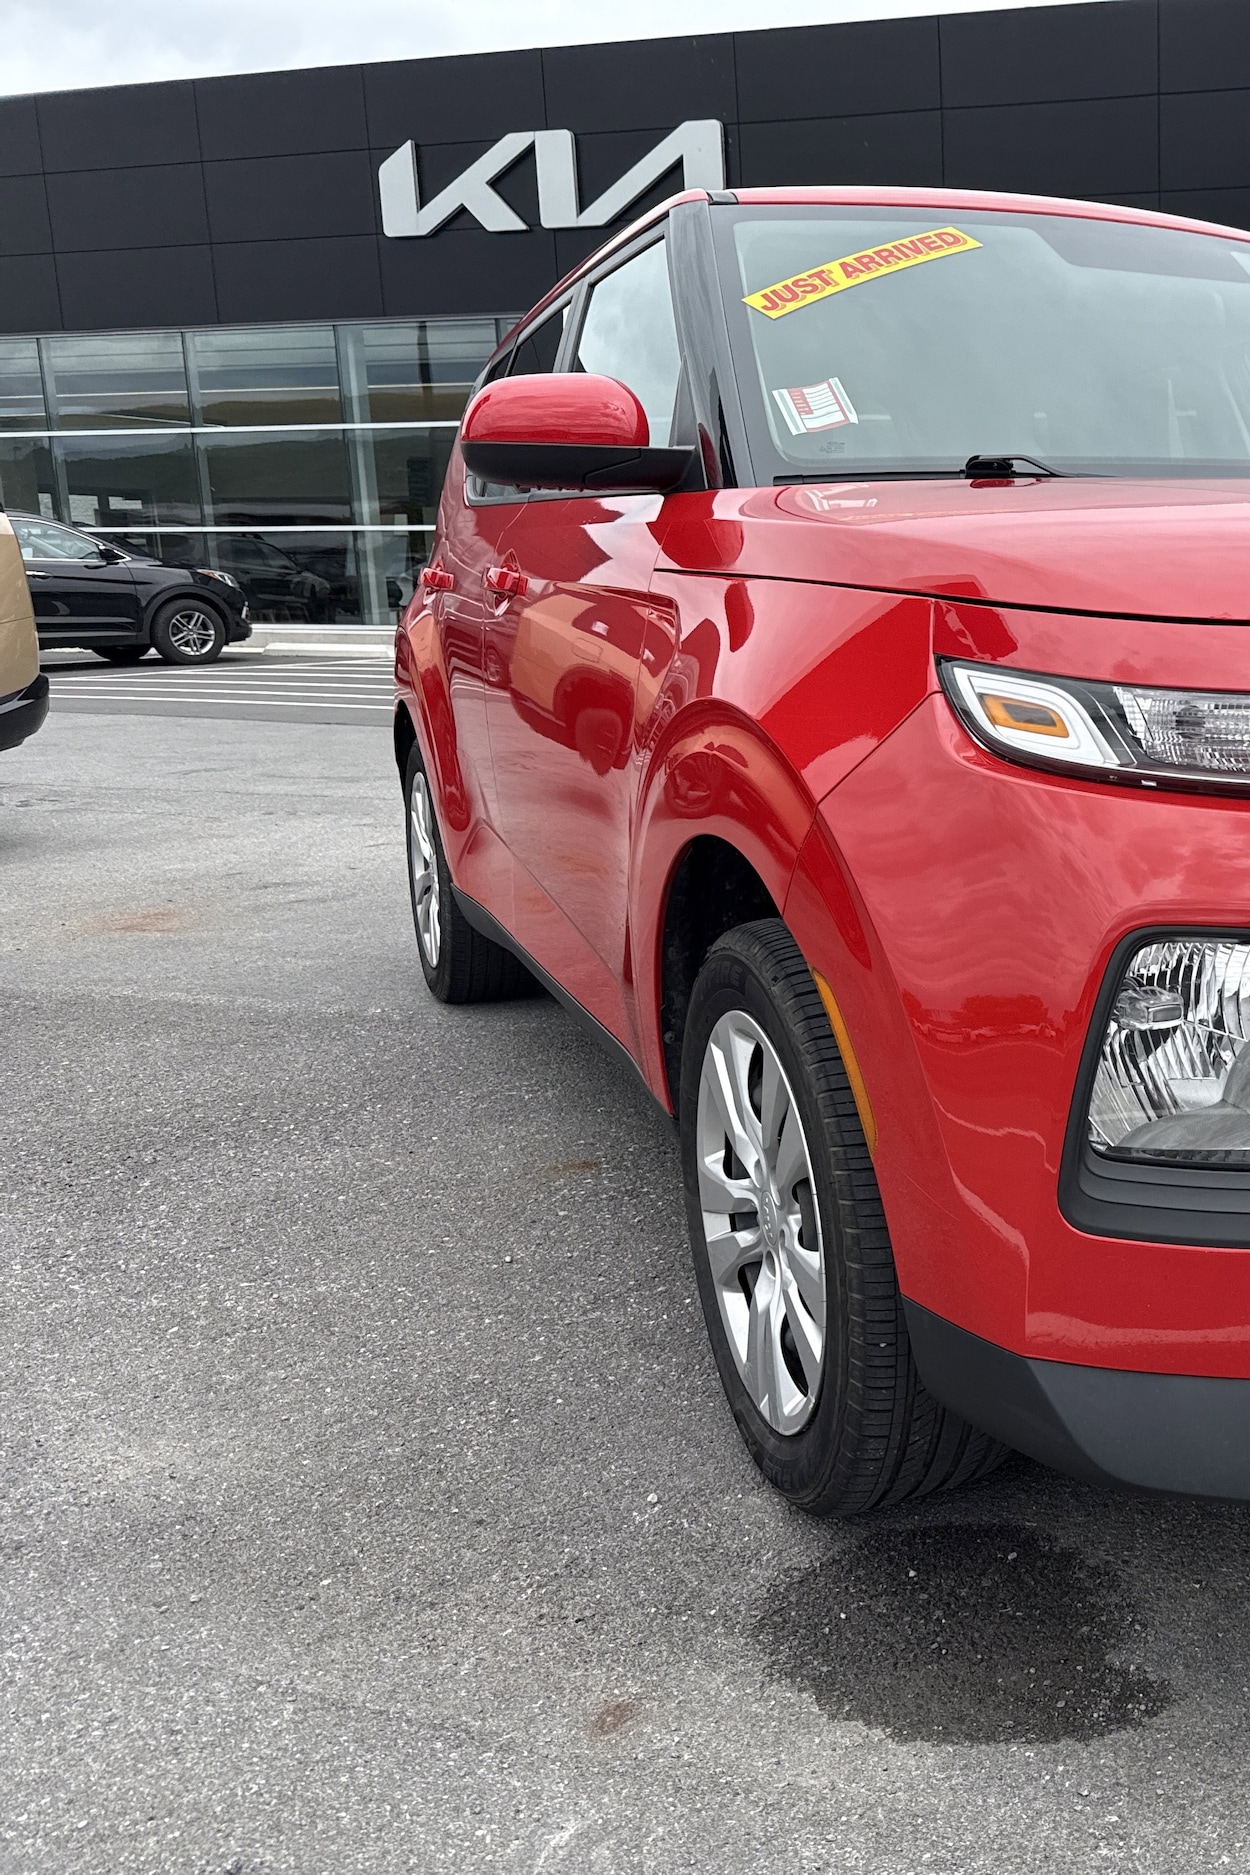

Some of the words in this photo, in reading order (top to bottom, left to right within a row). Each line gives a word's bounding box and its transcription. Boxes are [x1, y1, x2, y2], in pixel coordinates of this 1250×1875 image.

[379, 119, 725, 237] KIA
[760, 269, 838, 312] JUST
[839, 230, 967, 280] ARRIVED
